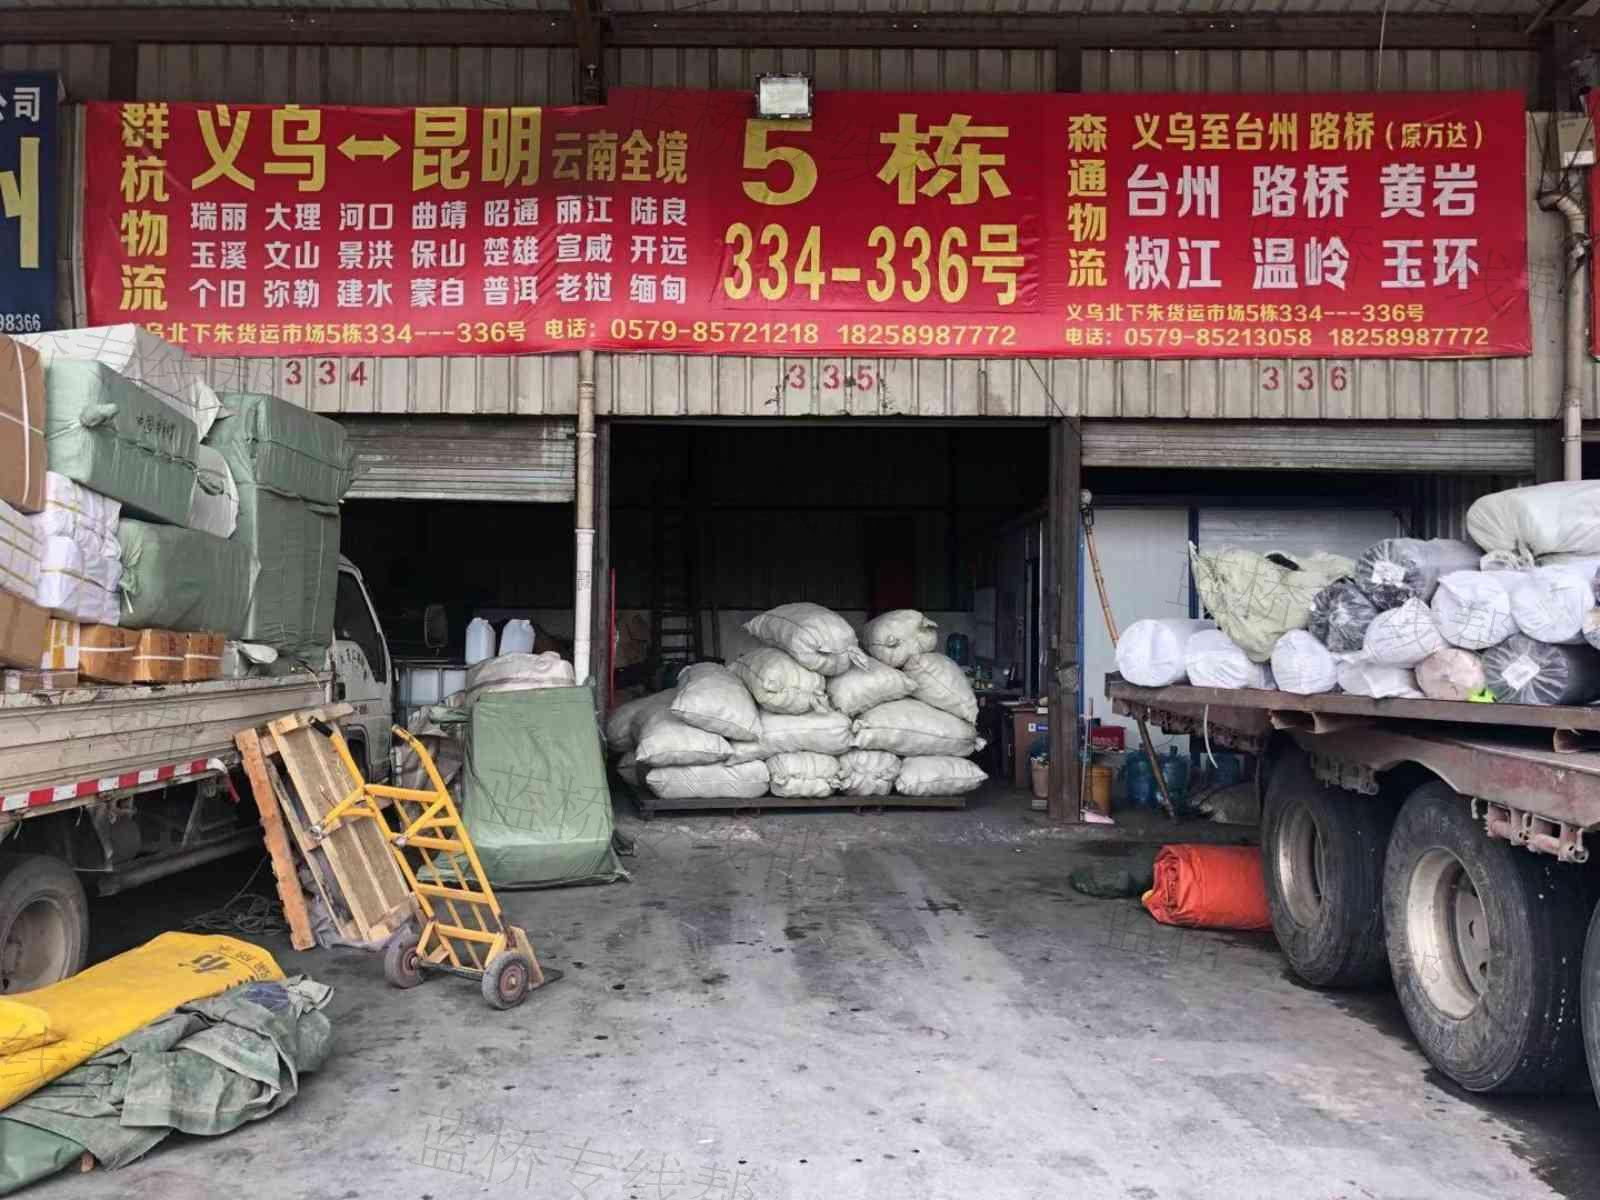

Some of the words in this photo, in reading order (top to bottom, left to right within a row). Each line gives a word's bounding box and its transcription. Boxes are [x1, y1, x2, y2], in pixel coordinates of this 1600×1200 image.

[192, 104, 325, 191] 义乌
[413, 106, 542, 191] 昆明
[552, 130, 687, 183] 云南全境
[120, 103, 169, 311] 群杭物流
[191, 202, 247, 231] 瑞丽
[265, 203, 320, 230] 大理
[339, 203, 392, 230] 河口
[412, 201, 466, 229] 曲靖
[485, 198, 538, 227] 昭通
[557, 195, 612, 224] 丽江
[631, 197, 687, 226] 陆良
[1068, 114, 1107, 287] 森通物流
[1128, 164, 1219, 218] 台州
[1252, 165, 1348, 218] 路桥
[1380, 163, 1477, 218] 黄岩
[191, 241, 246, 269] 玉溪
[264, 241, 319, 269] 文山
[338, 241, 393, 269] 景洪
[411, 239, 464, 268] 保山
[484, 235, 538, 266] 楚雄
[556, 233, 612, 262] 宣威
[631, 236, 687, 265] 开远
[725, 224, 1023, 304] 334-336号
[1125, 236, 1221, 290] 椒江
[1253, 237, 1349, 290] 温岭
[1381, 239, 1478, 289] 玉环
[190, 279, 245, 307] 个旧
[264, 279, 319, 308] 弥勒
[337, 279, 392, 307] 建水
[411, 278, 464, 307] 蒙自
[483, 276, 538, 305] 普洱
[556, 272, 611, 302] 老挝
[630, 274, 686, 304] 缅甸
[838, 324, 1016, 346] 18258987772
[1329, 328, 1488, 346] 18258987772
